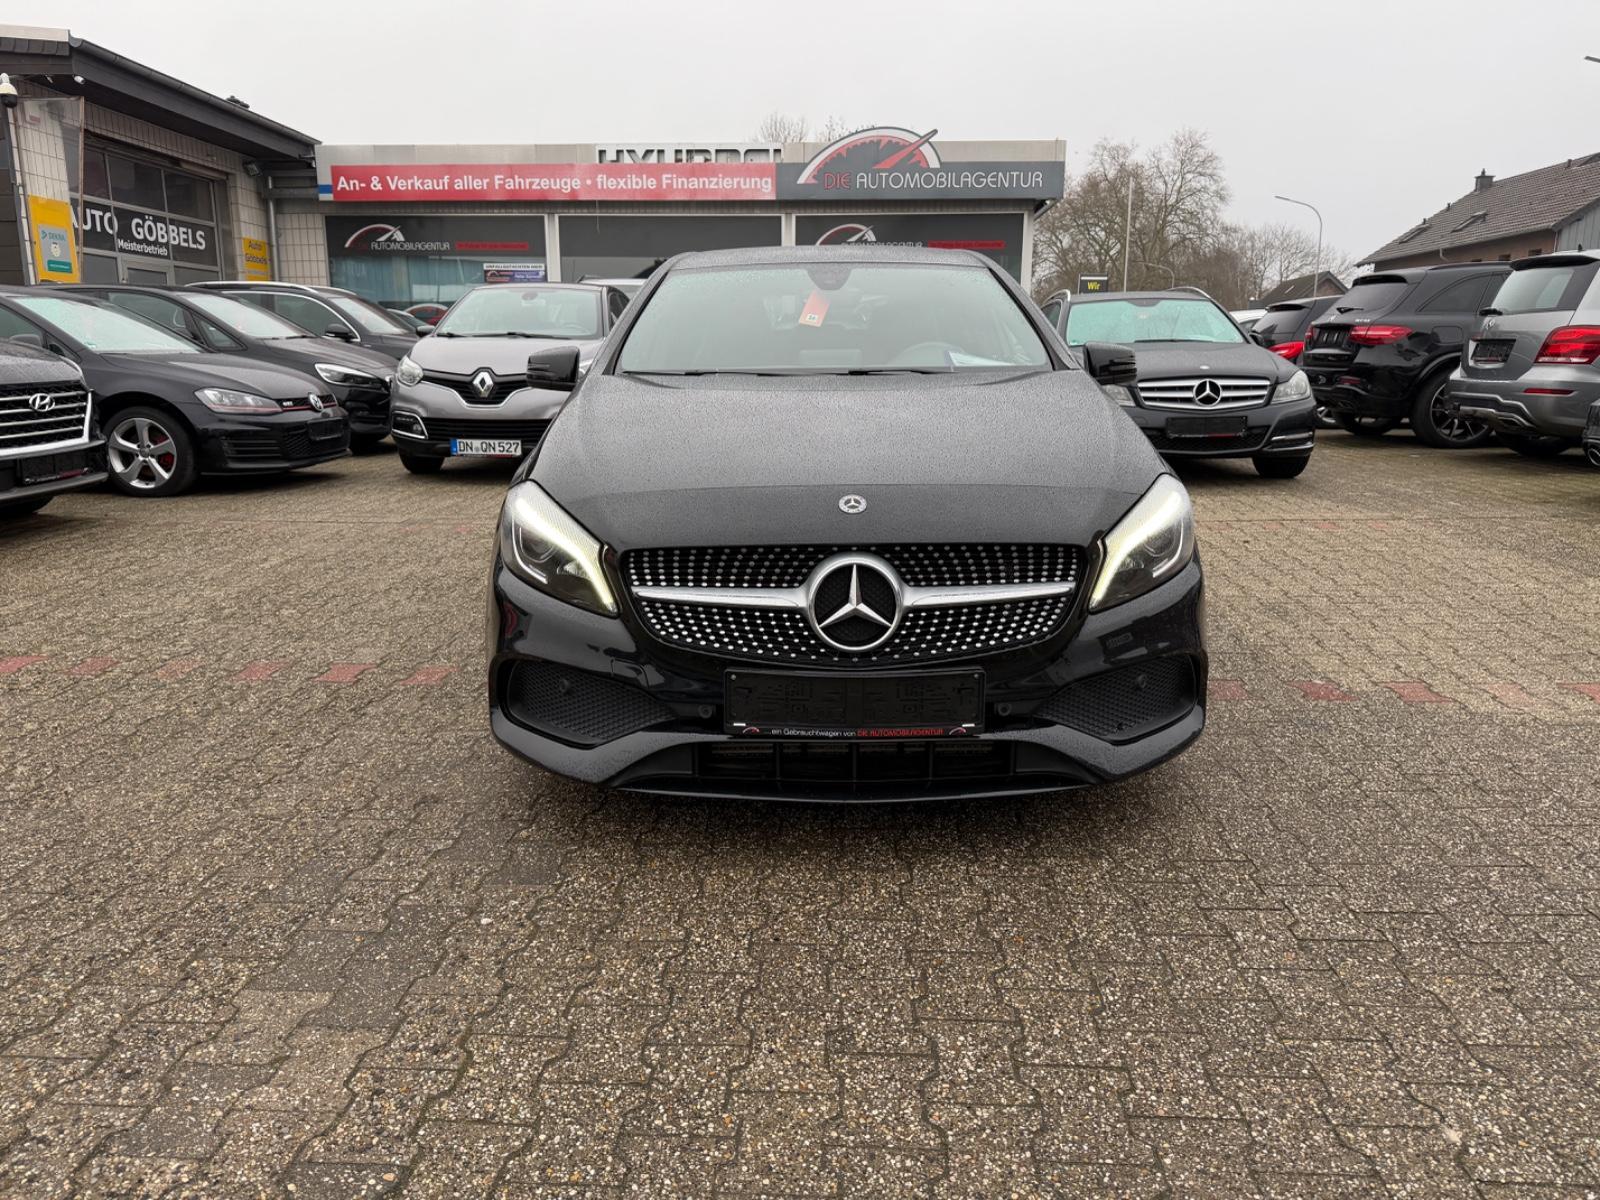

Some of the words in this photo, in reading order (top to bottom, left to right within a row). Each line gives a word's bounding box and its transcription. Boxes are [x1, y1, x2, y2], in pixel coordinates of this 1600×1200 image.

[337, 176, 366, 191] An-
[370, 176, 383, 191] &
[386, 176, 451, 191] Verkauf
[454, 175, 492, 190] aller
[494, 175, 581, 193] Fahrzeuge
[596, 174, 657, 190] flexible
[662, 174, 772, 192] Finanzierung
[823, 172, 852, 190] DIE
[856, 171, 1043, 189] AUTOMOBILAGENTUR
[131, 216, 206, 250] GÖBBELS
[117, 238, 168, 256] Meisterbetrieb
[371, 241, 450, 250] AUTOMOBILAGENTUR
[458, 441, 474, 452] DN
[498, 441, 520, 453] 527
